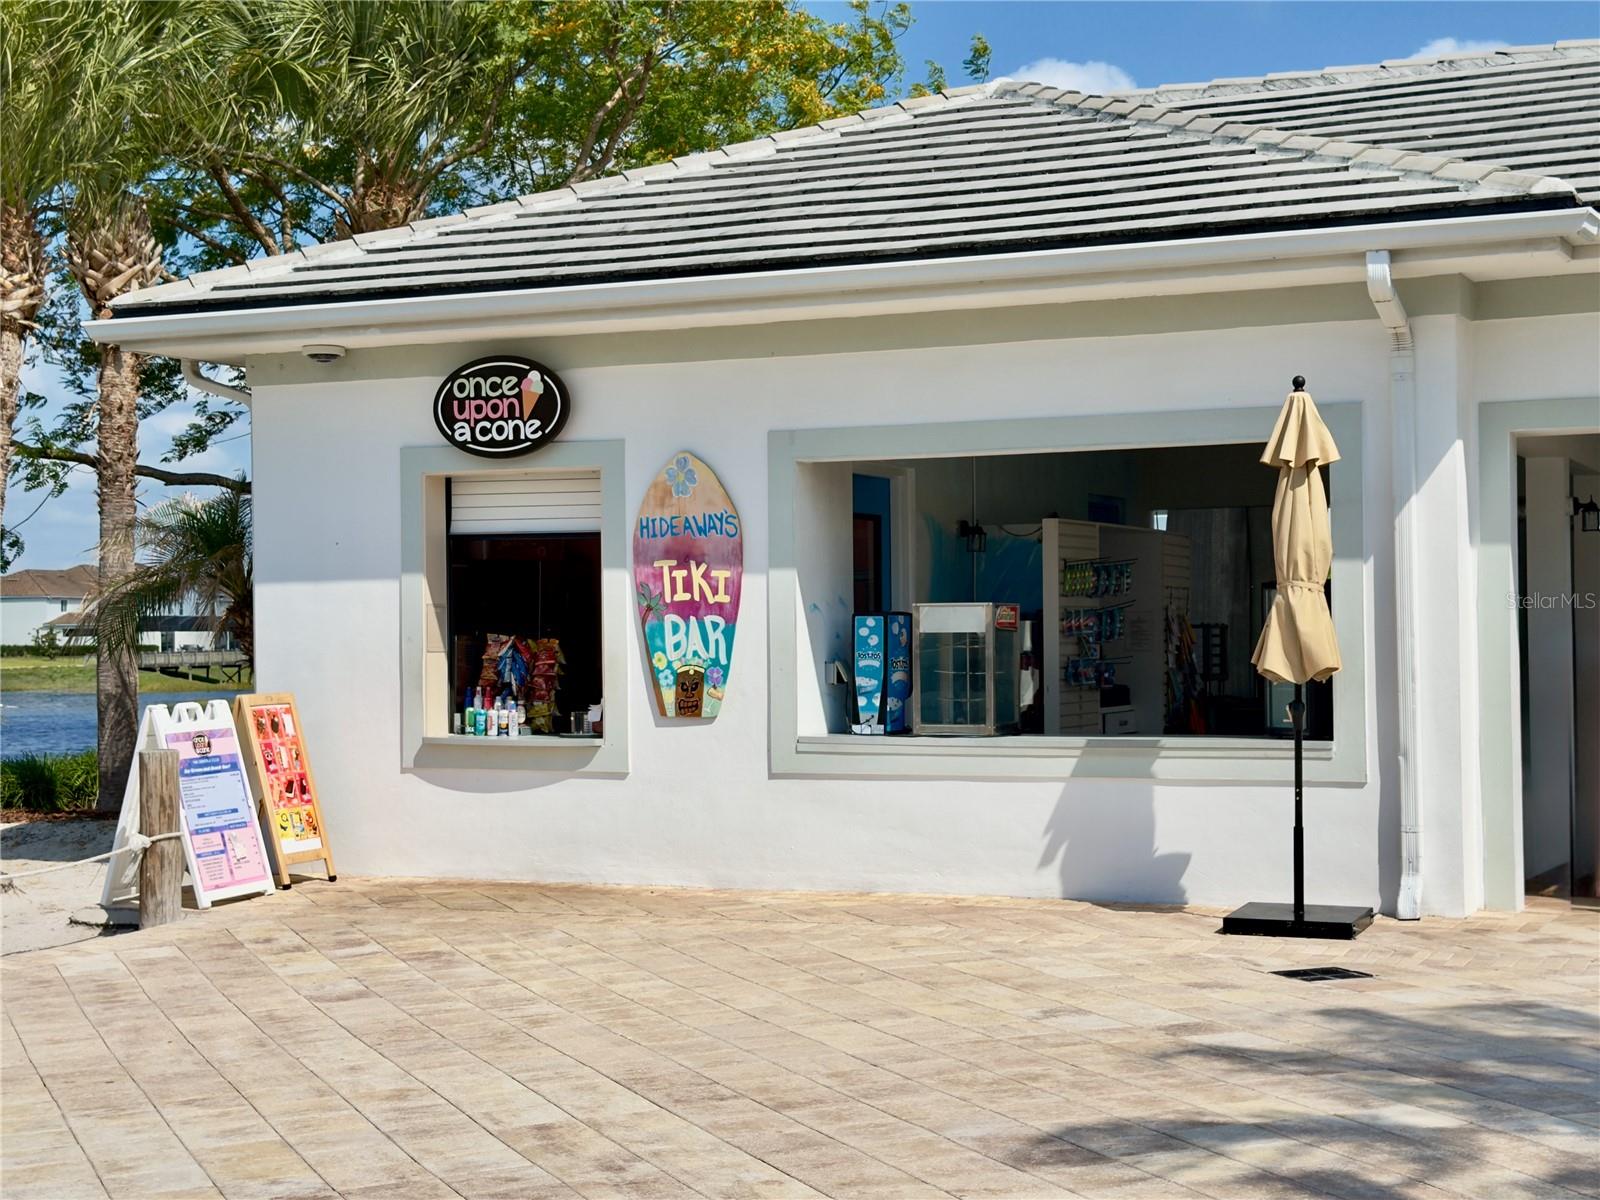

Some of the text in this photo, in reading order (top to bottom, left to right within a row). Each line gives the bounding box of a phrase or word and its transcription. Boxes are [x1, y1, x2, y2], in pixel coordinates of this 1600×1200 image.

[453, 376, 519, 398] once
[453, 397, 520, 427] upon
[453, 419, 542, 442] a cone
[639, 509, 738, 539] HIDEAWAY'S
[653, 559, 731, 604] TIKI
[664, 613, 728, 665] BAR
